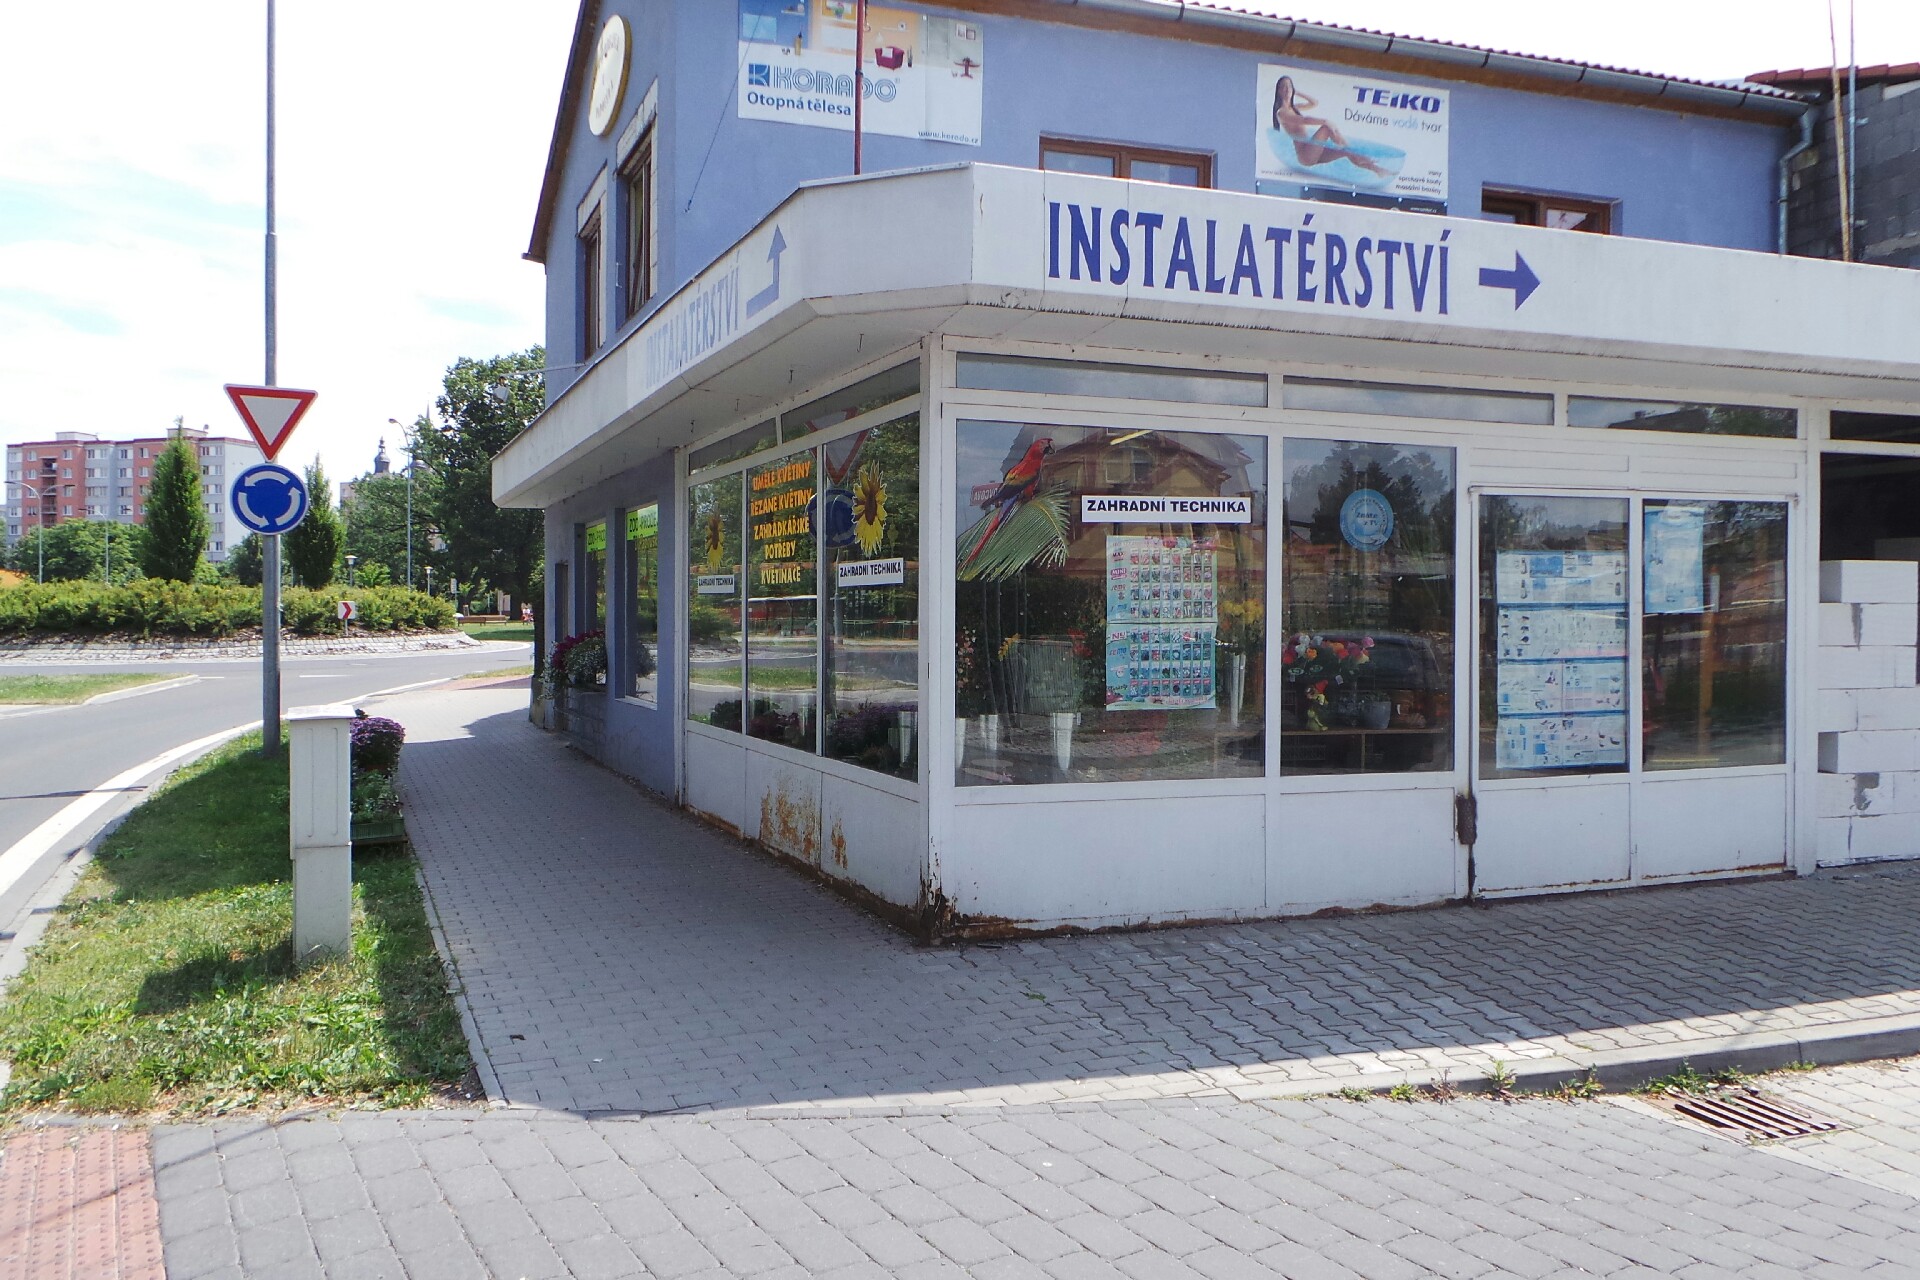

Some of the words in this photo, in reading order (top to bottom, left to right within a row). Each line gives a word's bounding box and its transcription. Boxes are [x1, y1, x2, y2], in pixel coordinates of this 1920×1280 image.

[773, 66, 897, 102] KORADO
[747, 91, 804, 111] Otopná
[807, 97, 851, 116] tělesa
[1344, 108, 1389, 126] Dáváme
[1421, 119, 1443, 133] tvar
[1048, 200, 1452, 315] INSTALATÉRSTVÍ
[646, 249, 741, 389] INSTALATÉRSTVÍ
[777, 460, 811, 484] KVĚTINY
[778, 488, 813, 511] KVĚTINY
[1087, 497, 1166, 512] ZAHRADNÍ
[1170, 500, 1246, 513] TECHNIKA
[765, 539, 796, 560] POTŘEBY
[840, 562, 869, 578] ZAHRADNÍ
[870, 562, 901, 576] TECHNIKA
